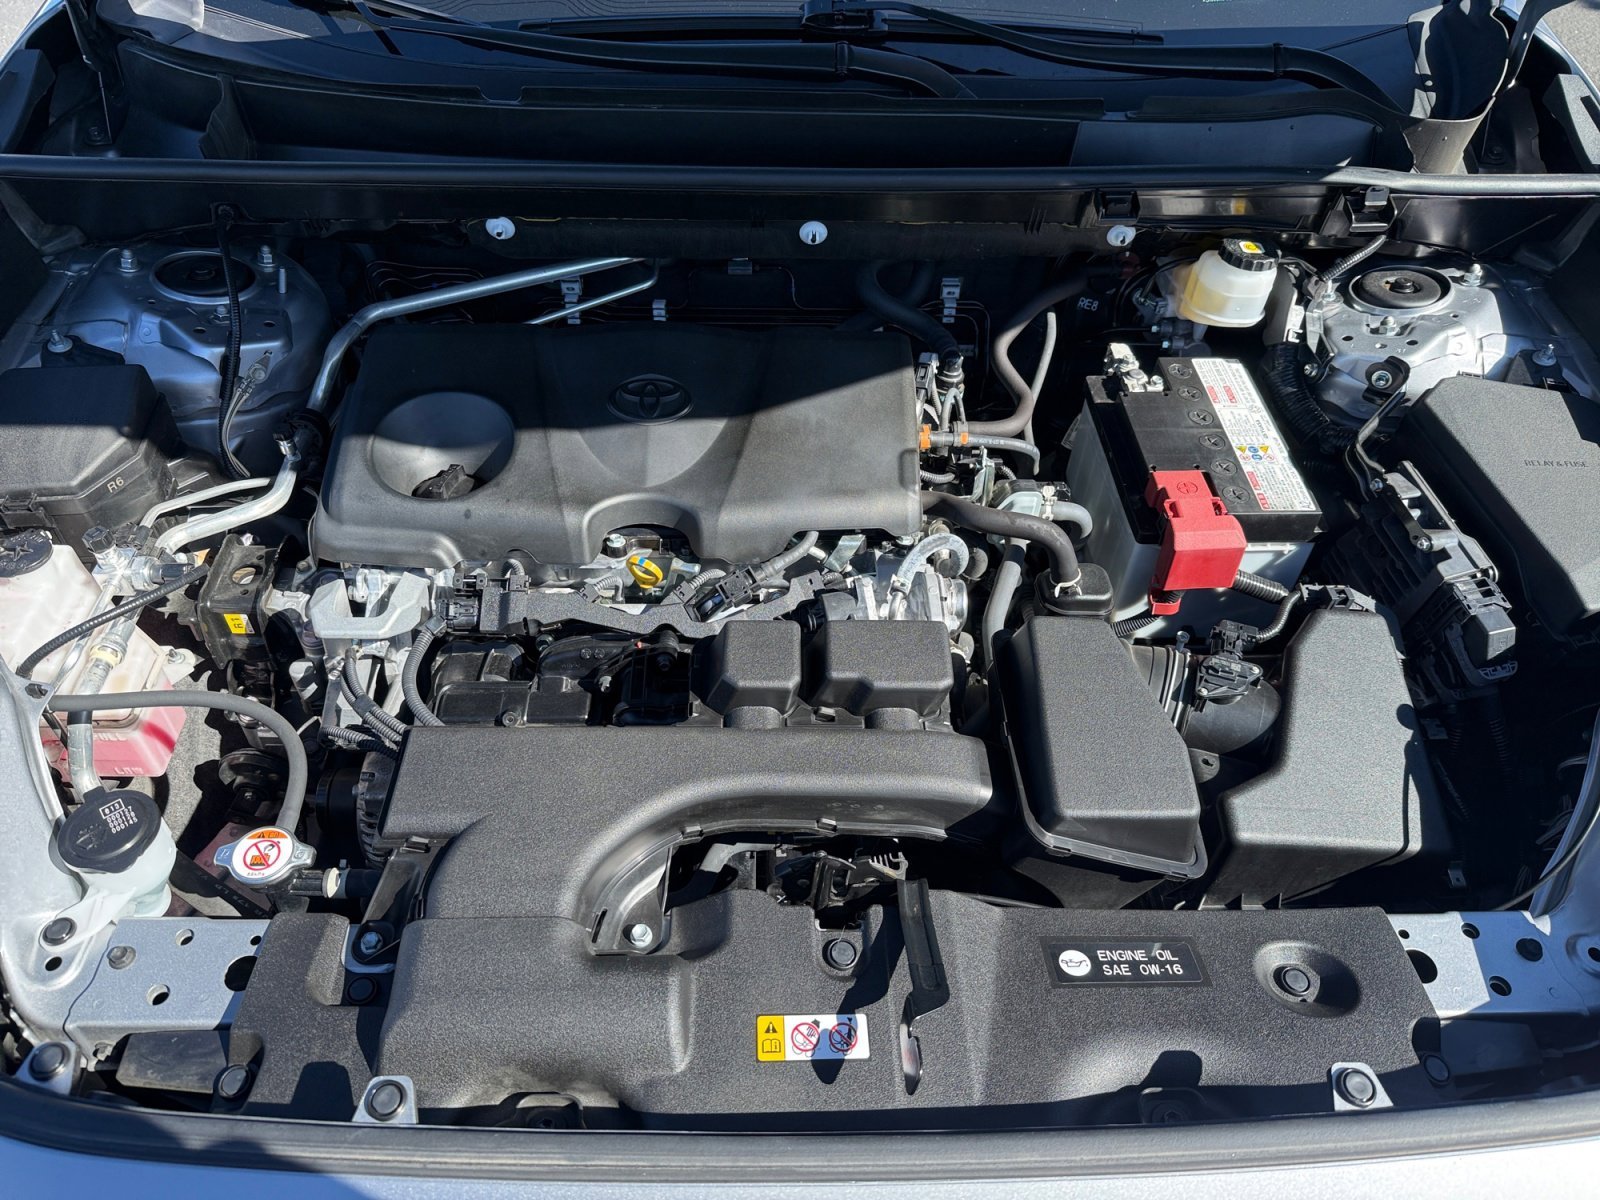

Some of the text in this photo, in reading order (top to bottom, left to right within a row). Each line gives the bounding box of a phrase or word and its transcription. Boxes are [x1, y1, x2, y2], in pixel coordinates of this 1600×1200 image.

[1078, 297, 1099, 311] RE8
[107, 476, 124, 493] R6
[1097, 950, 1179, 961] ENGINE OIL
[1102, 964, 1184, 975] SAE 0W-16
